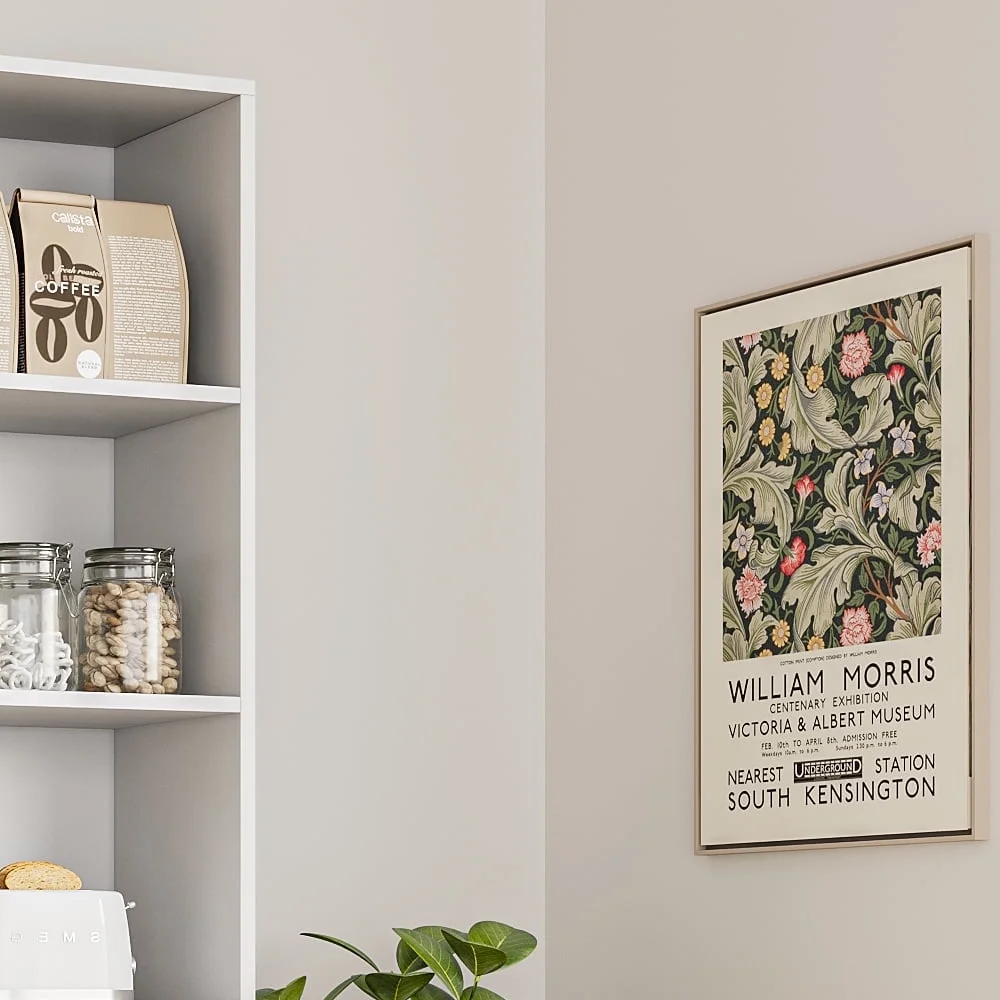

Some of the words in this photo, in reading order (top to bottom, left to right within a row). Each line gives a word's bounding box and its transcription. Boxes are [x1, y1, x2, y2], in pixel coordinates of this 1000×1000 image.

[34, 280, 100, 297] COFFEE
[728, 669, 824, 704] WILLIAM
[843, 656, 936, 691] MORRIS
[769, 698, 826, 714] CENTENARY
[832, 691, 889, 707] EXHIBITION
[728, 718, 792, 739] VICTORIA
[797, 716, 807, 732] &
[812, 710, 865, 730] ALBERT
[871, 703, 936, 724] MUSEUM
[793, 739, 801, 747] TO
[805, 737, 823, 746] APRIL
[842, 732, 878, 743] ADMISSION
[881, 730, 898, 739] FREE
[727, 766, 784, 786] NEAREST
[794, 758, 862, 778] UNDERGROUND
[875, 753, 935, 774] STATION
[728, 787, 790, 812] SOUTH
[805, 776, 935, 806] KENSINGTON
